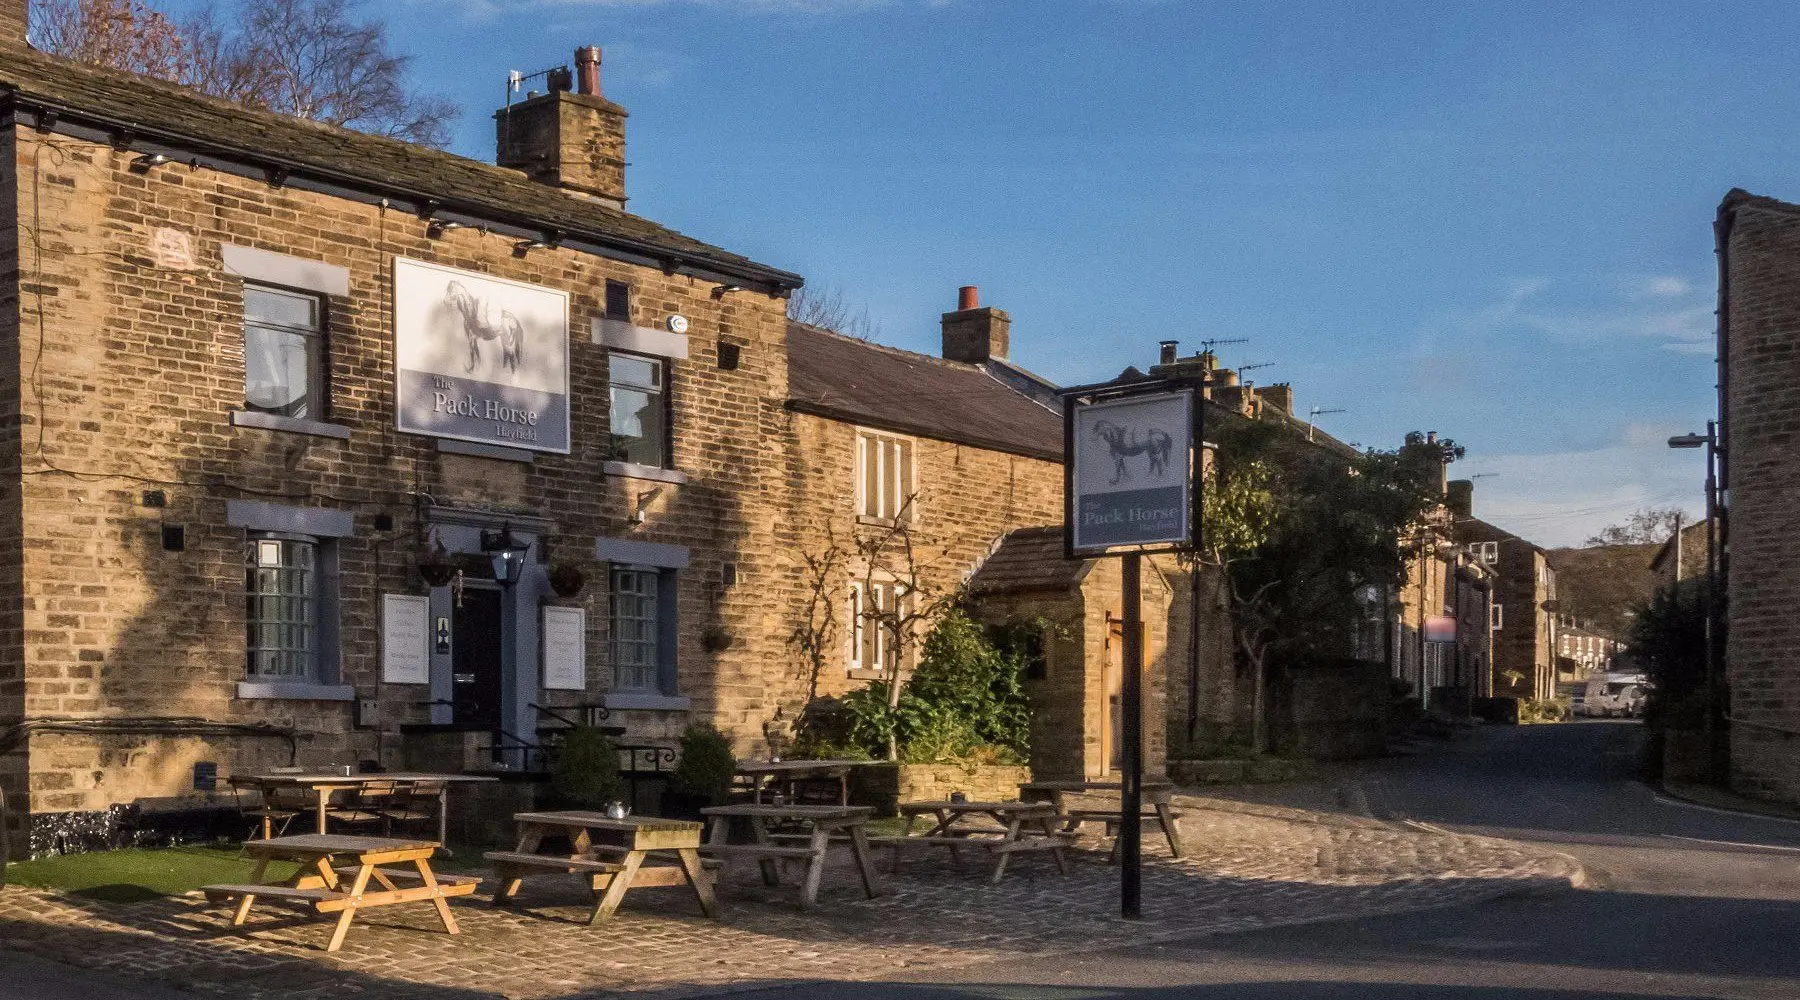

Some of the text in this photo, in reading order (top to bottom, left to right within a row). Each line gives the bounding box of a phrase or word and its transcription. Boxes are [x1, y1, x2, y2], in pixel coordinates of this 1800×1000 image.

[432, 375, 454, 390] The
[433, 391, 538, 426] Pack Horse
[496, 424, 537, 441] Hayfield
[1084, 507, 1179, 526] Pack Horse
